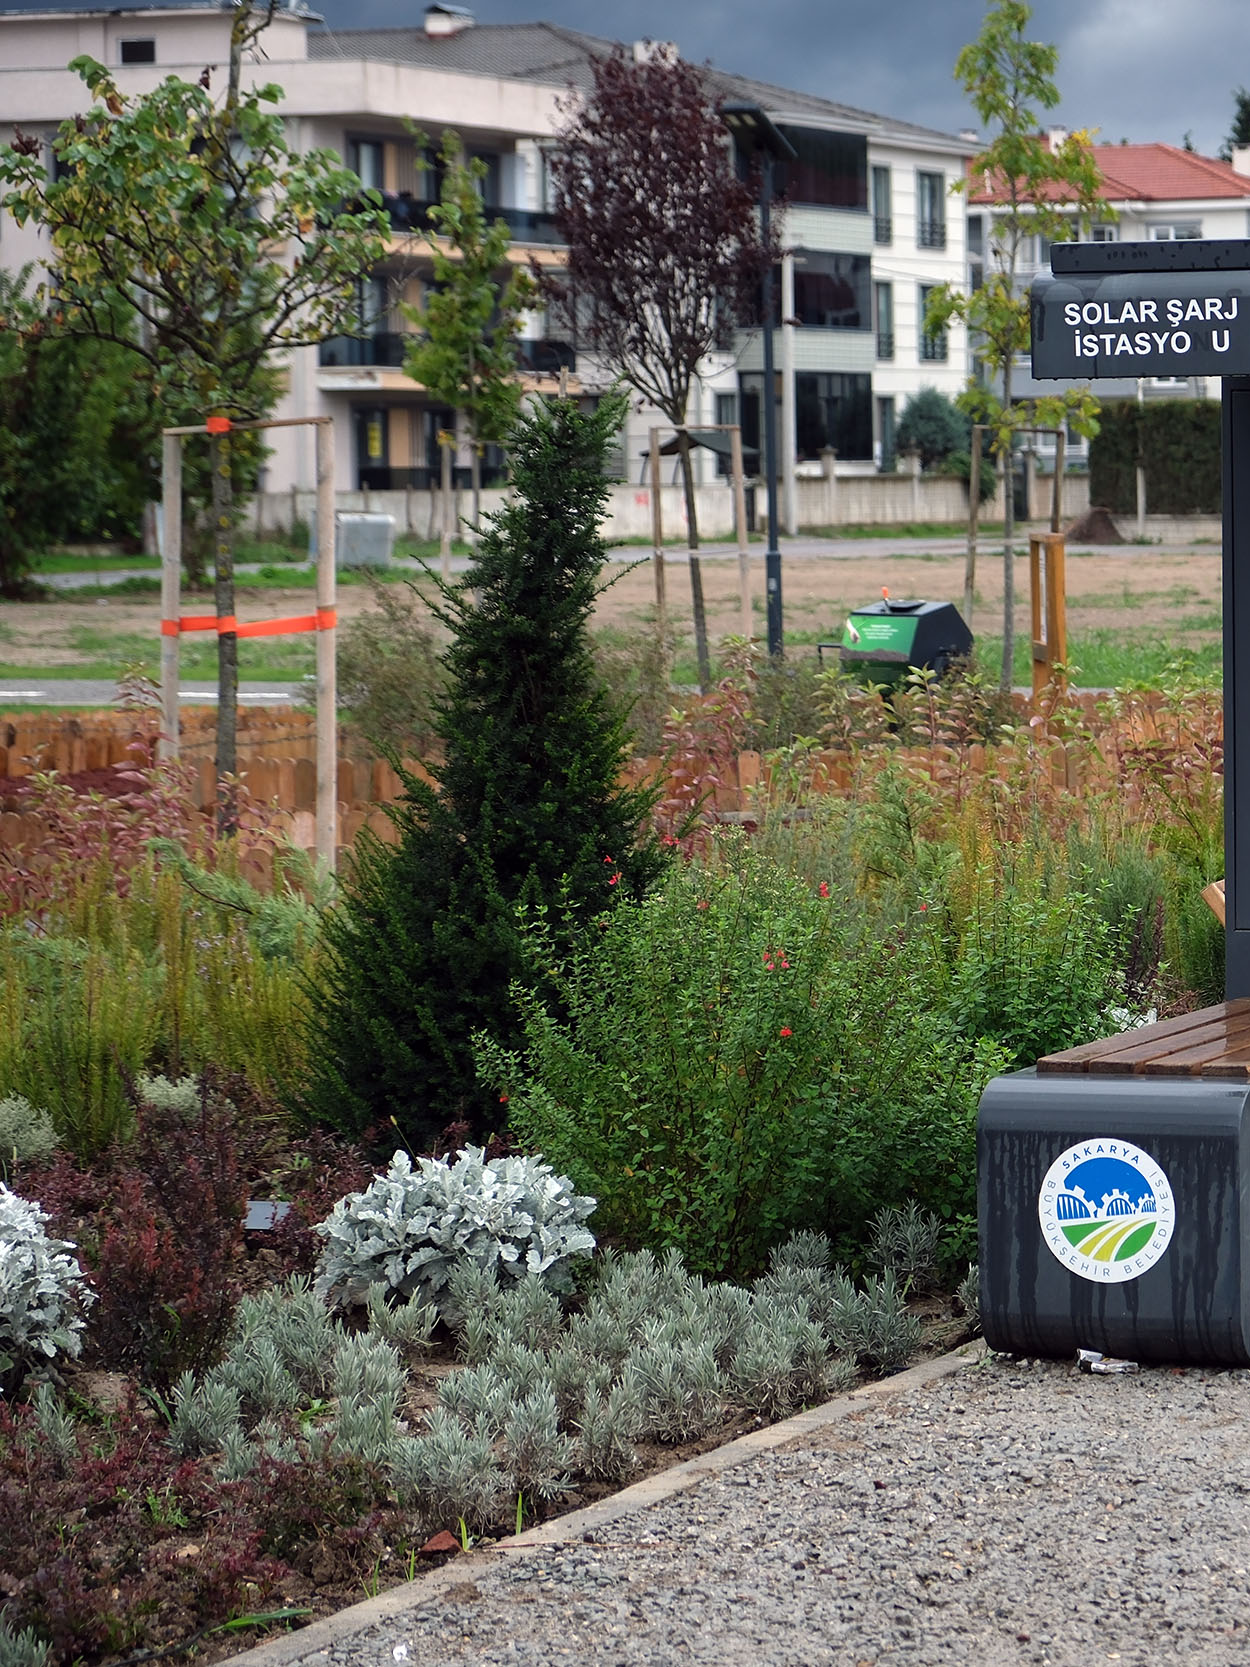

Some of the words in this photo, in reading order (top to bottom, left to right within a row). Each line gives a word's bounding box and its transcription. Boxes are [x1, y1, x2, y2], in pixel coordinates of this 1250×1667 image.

[1064, 301, 1159, 326] SOLAR
[1166, 297, 1238, 327] ŞARJ
[1062, 1144, 1141, 1170] SAKARYA
